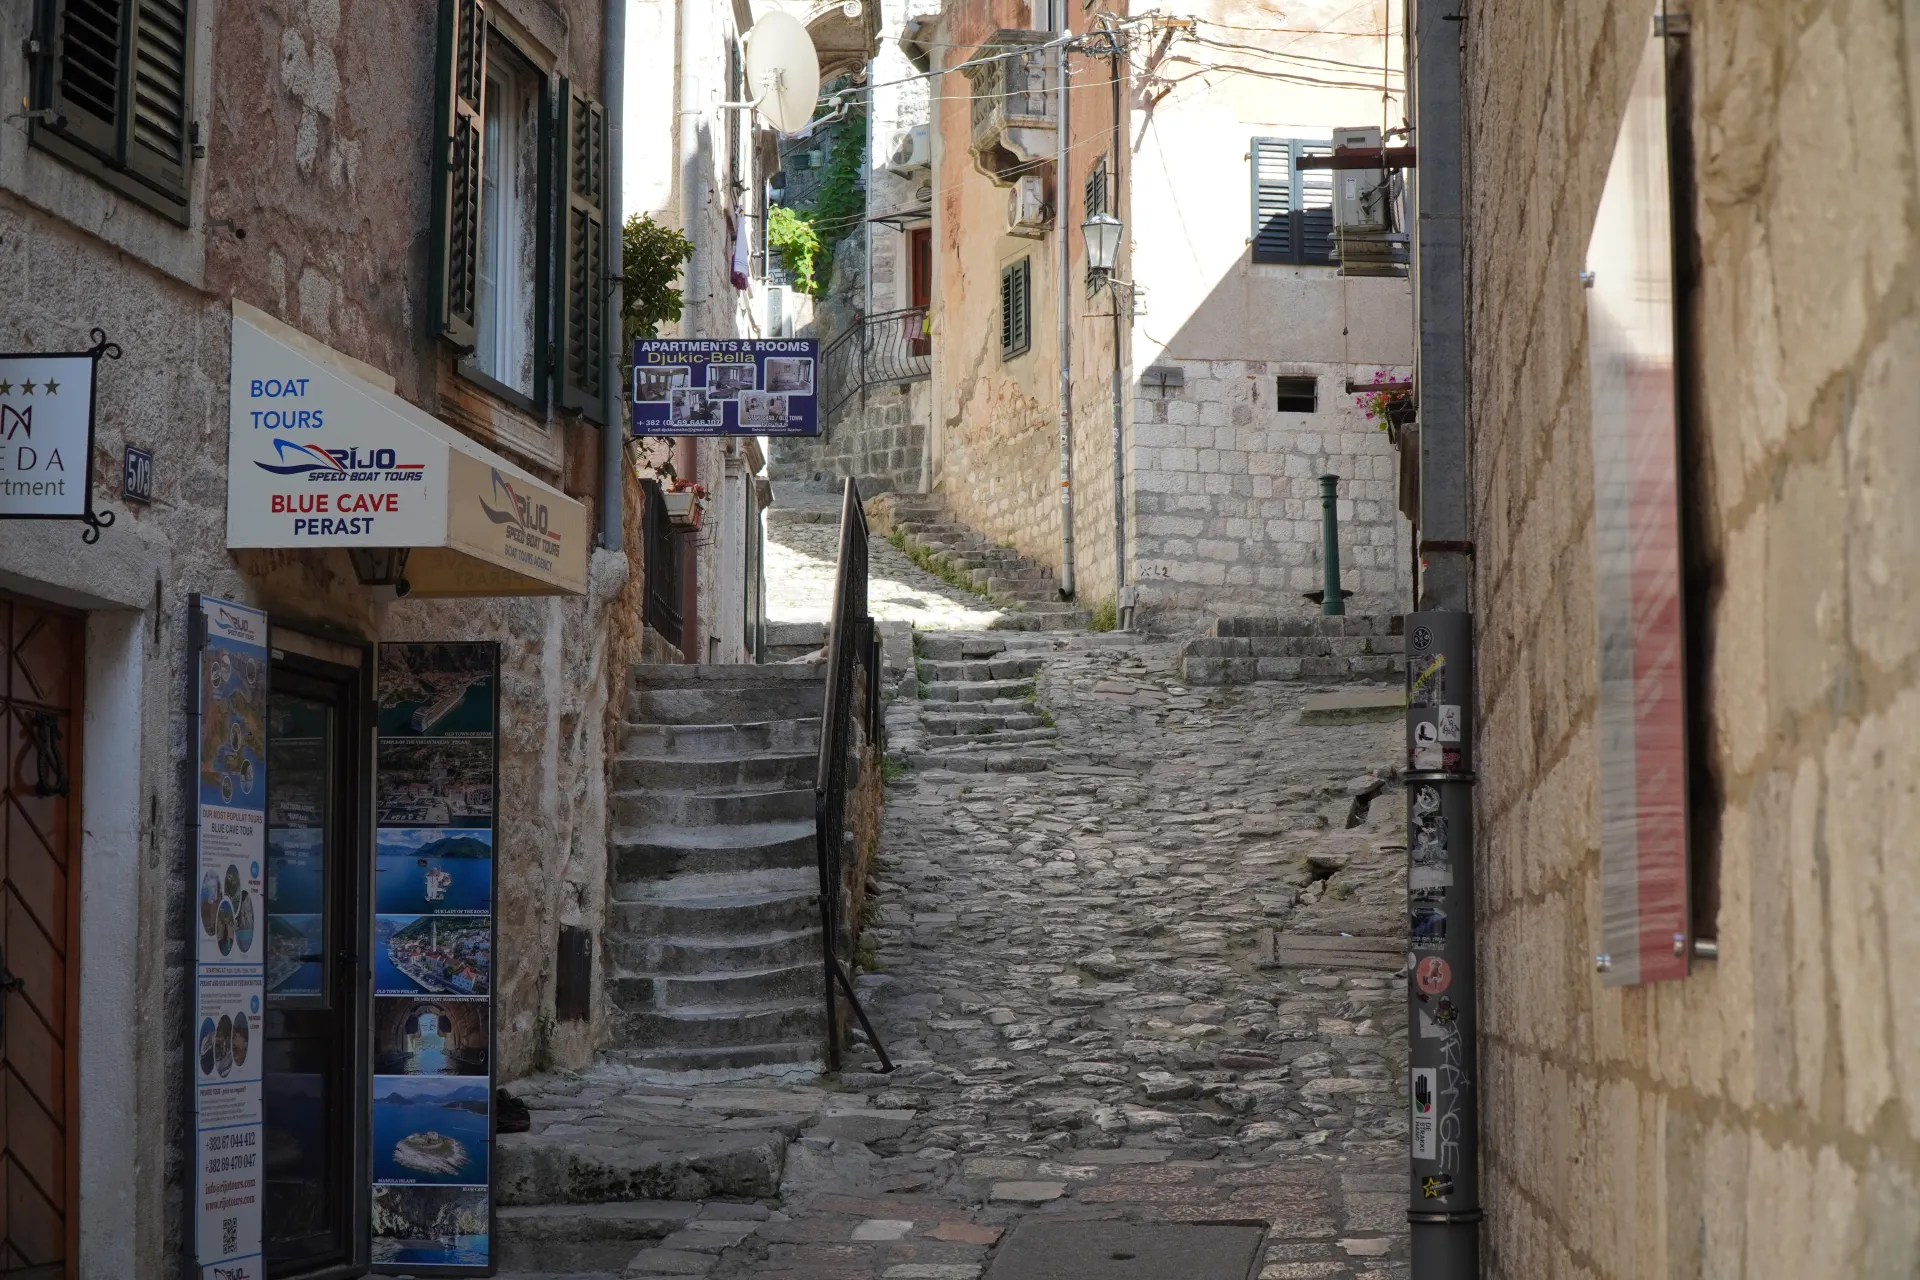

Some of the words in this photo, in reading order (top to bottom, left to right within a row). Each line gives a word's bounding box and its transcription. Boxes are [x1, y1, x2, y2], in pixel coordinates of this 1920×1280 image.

[641, 342, 738, 352] APARTMENTS
[741, 342, 752, 352] &
[755, 342, 810, 352] ROOMS
[647, 351, 756, 366] Djukic-Bella
[250, 379, 310, 398] BOAT
[250, 410, 323, 429] TOURS
[126, 454, 151, 497] 503
[307, 472, 347, 482] SPEED
[349, 472, 381, 481] BOAT
[384, 471, 423, 481] TOURS
[271, 494, 329, 513] BLUE
[336, 493, 399, 512] CAVE
[294, 517, 375, 536] PERAST
[506, 525, 526, 545] SPEED
[525, 531, 541, 550] BOAT
[542, 538, 560, 557] TOURS
[504, 543, 517, 558] BOAT
[518, 548, 534, 566] TOURS
[534, 552, 552, 573] AGENCY
[202, 809, 213, 818] OUR
[213, 810, 226, 820] MOST
[247, 814, 263, 824] TOURS
[211, 823, 225, 833] BLUE
[225, 825, 239, 835] CAVE
[240, 826, 254, 836] TOUR
[205, 1136, 221, 1152] +382
[221, 1135, 230, 1150] 67
[230, 1134, 243, 1149] 044
[244, 1132, 256, 1146] 412
[204, 1158, 221, 1174] +382
[221, 1156, 230, 1172] 69
[230, 1154, 243, 1170] 470
[243, 1153, 257, 1168] 047
[204, 1178, 256, 1195] info@rijotours.com
[204, 1195, 256, 1212] www.rijotours.com
